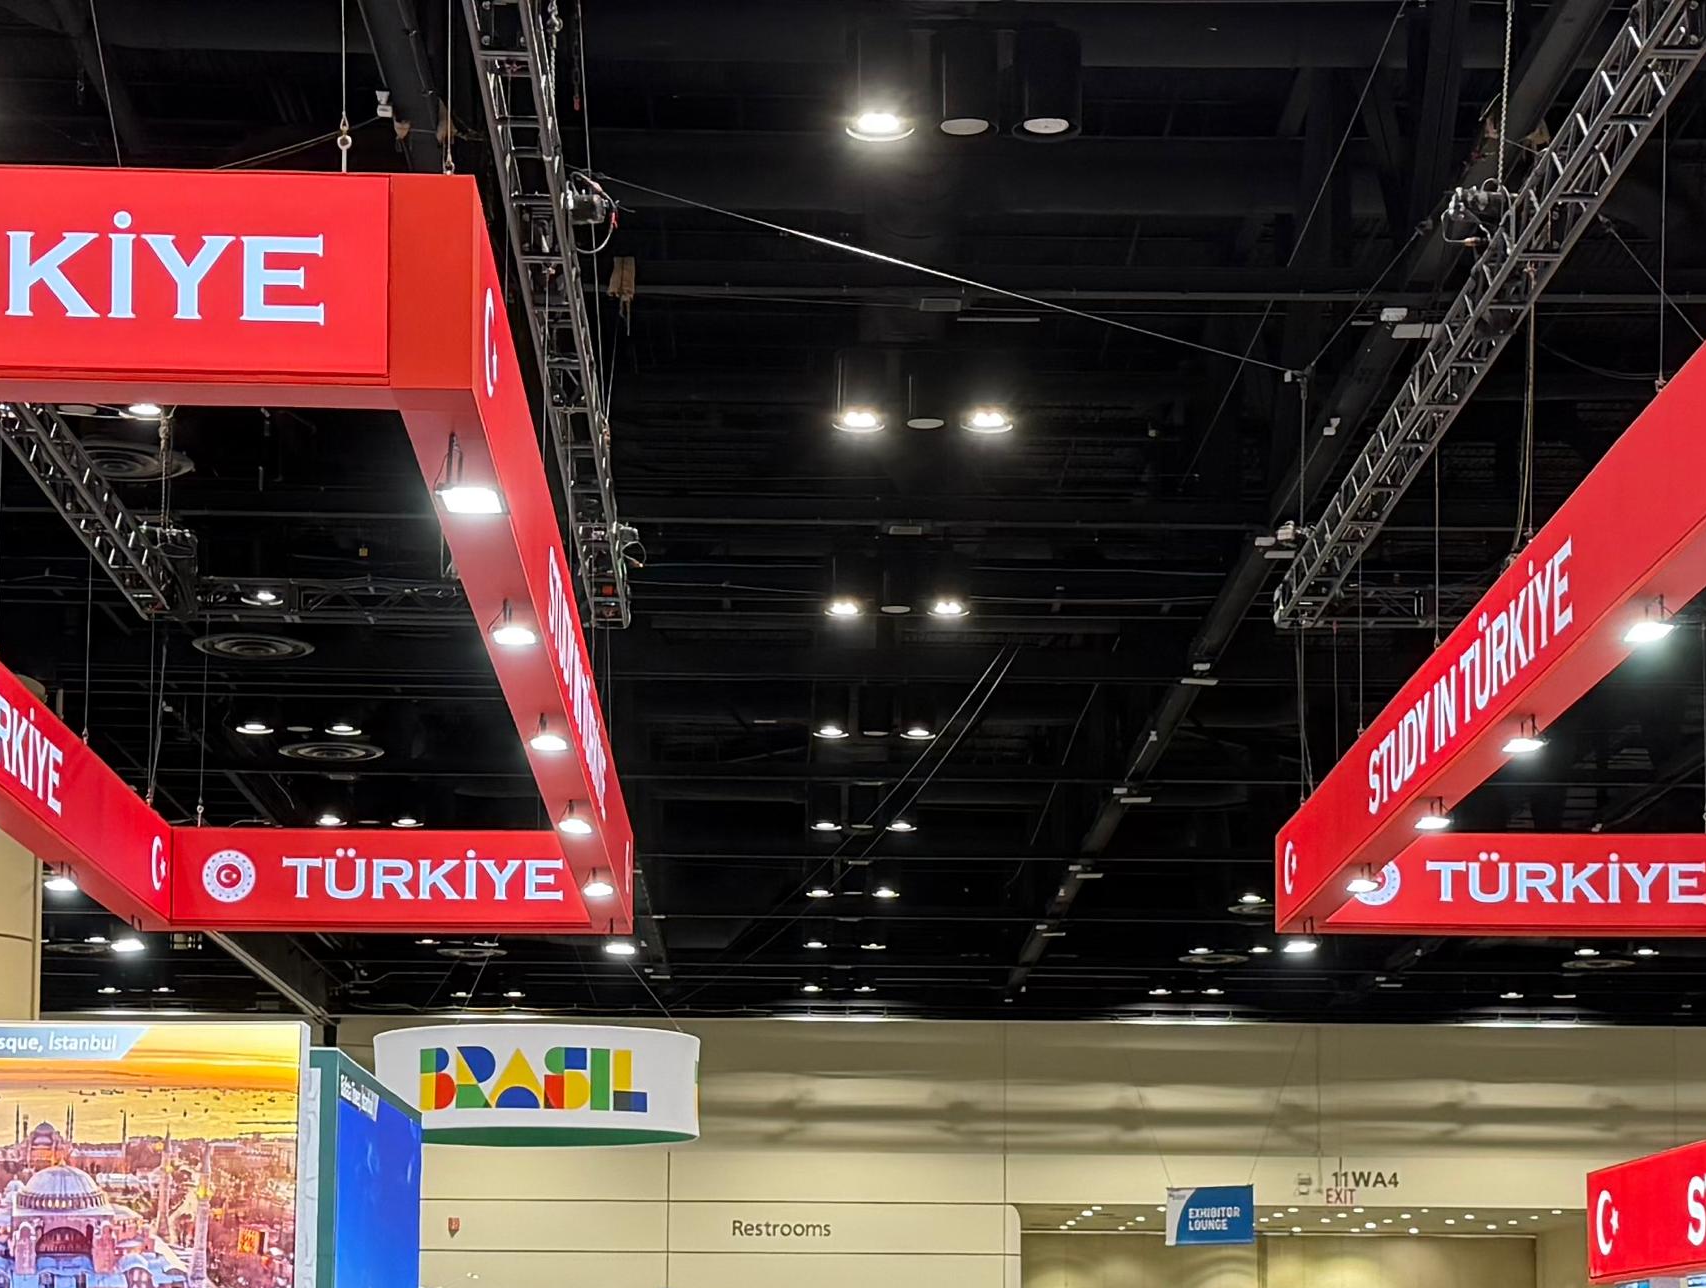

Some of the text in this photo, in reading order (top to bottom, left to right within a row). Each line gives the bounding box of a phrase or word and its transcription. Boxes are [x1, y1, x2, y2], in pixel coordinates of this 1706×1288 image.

[1368, 534, 1573, 815] STUDY IN TÜRKİYE
[281, 847, 564, 902] TÜRKİYE
[420, 1045, 648, 1113] BRASIL
[1326, 1188, 1356, 1204] EXIT
[1188, 1207, 1240, 1219] EXHIBITOR
[732, 1220, 831, 1237] Restrooms
[1188, 1219, 1228, 1231] LOUNGE
